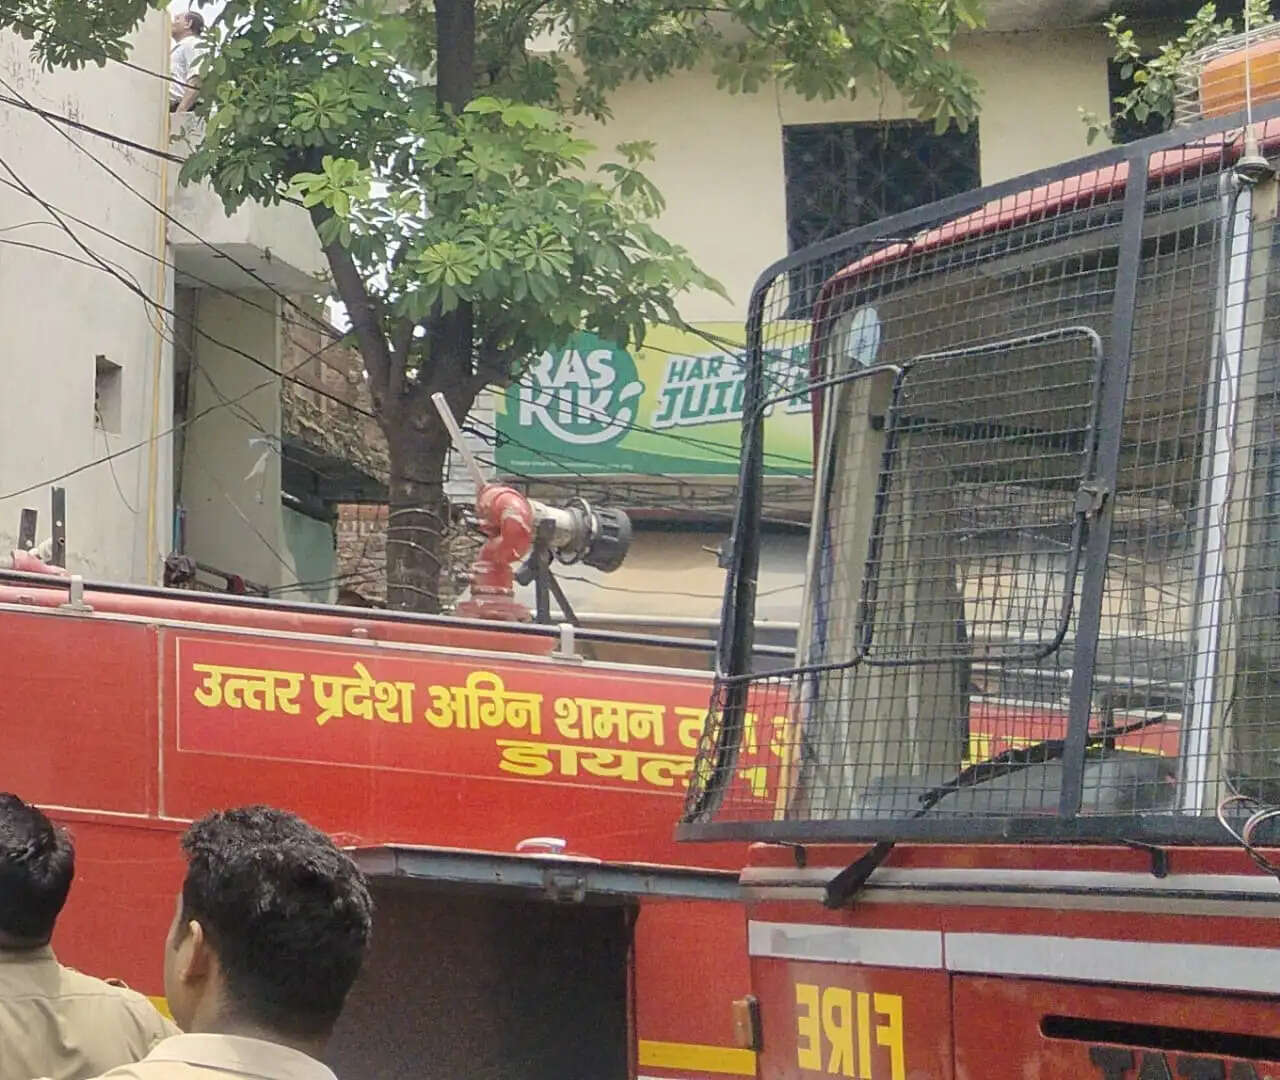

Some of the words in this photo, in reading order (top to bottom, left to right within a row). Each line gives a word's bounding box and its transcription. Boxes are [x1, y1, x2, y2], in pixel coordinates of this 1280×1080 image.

[520, 348, 616, 389] RAS
[667, 355, 725, 384] HAR
[519, 387, 621, 432] KIK
[193, 662, 305, 715] उत्तर
[310, 661, 415, 726] प्रदेश
[424, 670, 543, 735] अग्नि
[554, 696, 667, 747] शमन
